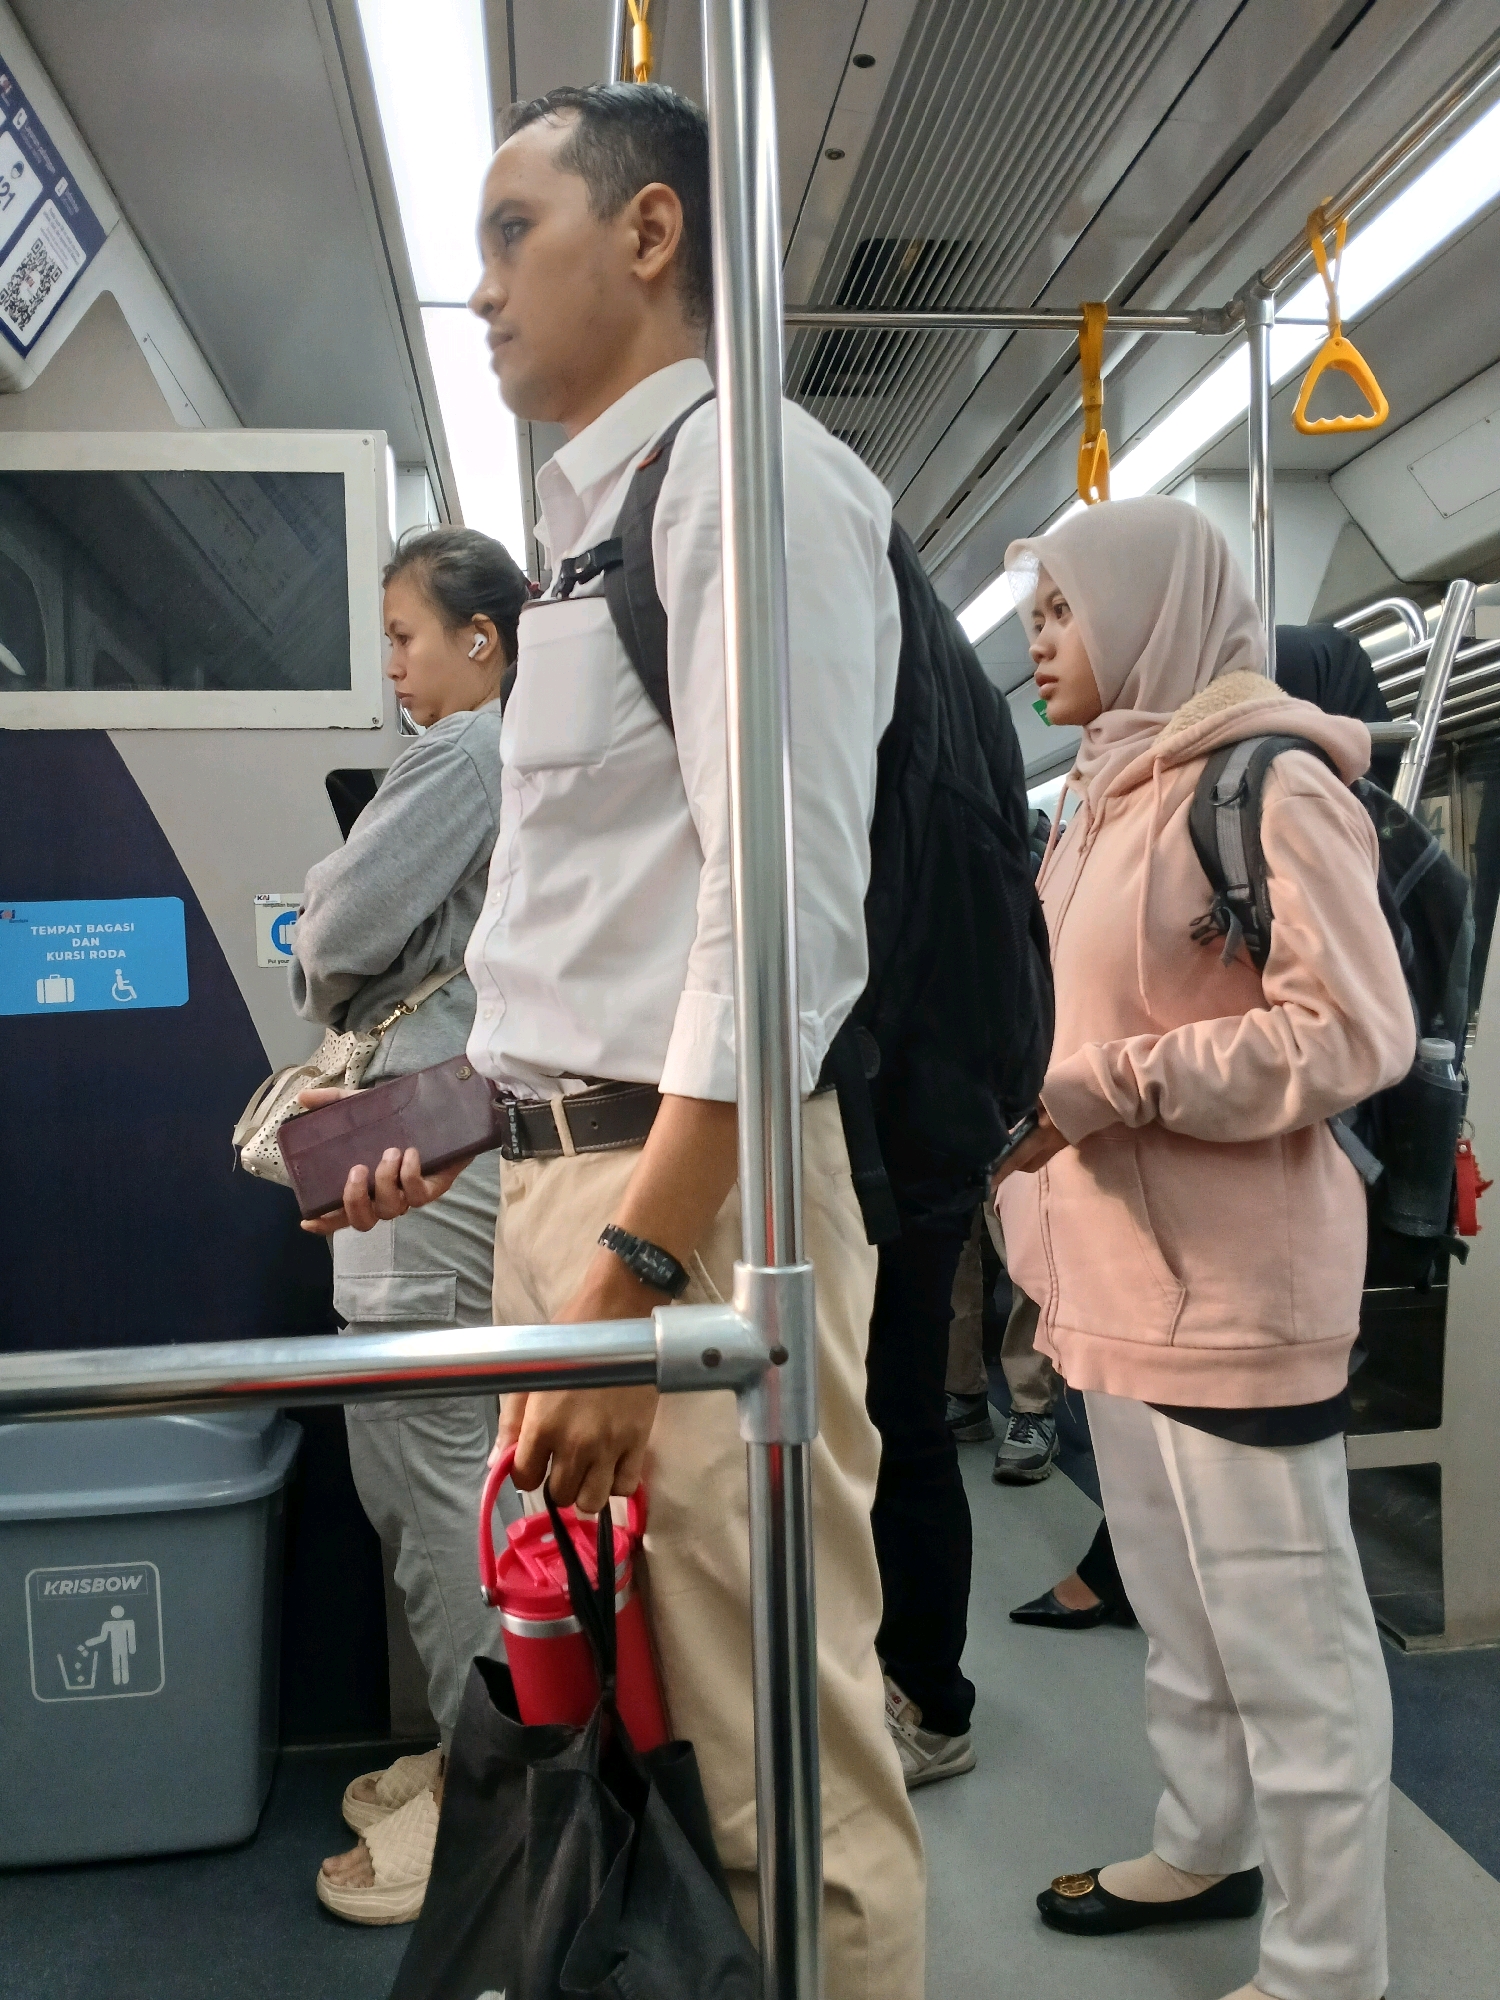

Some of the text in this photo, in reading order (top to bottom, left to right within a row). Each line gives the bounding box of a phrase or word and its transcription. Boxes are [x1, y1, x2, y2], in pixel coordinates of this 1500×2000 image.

[0, 175, 16, 211] 21
[30, 922, 135, 936] TEMPAT BAGASI
[71, 937, 100, 947] DAN
[46, 949, 127, 961] KURSI RODA
[43, 1574, 143, 1596] KRISBOW
